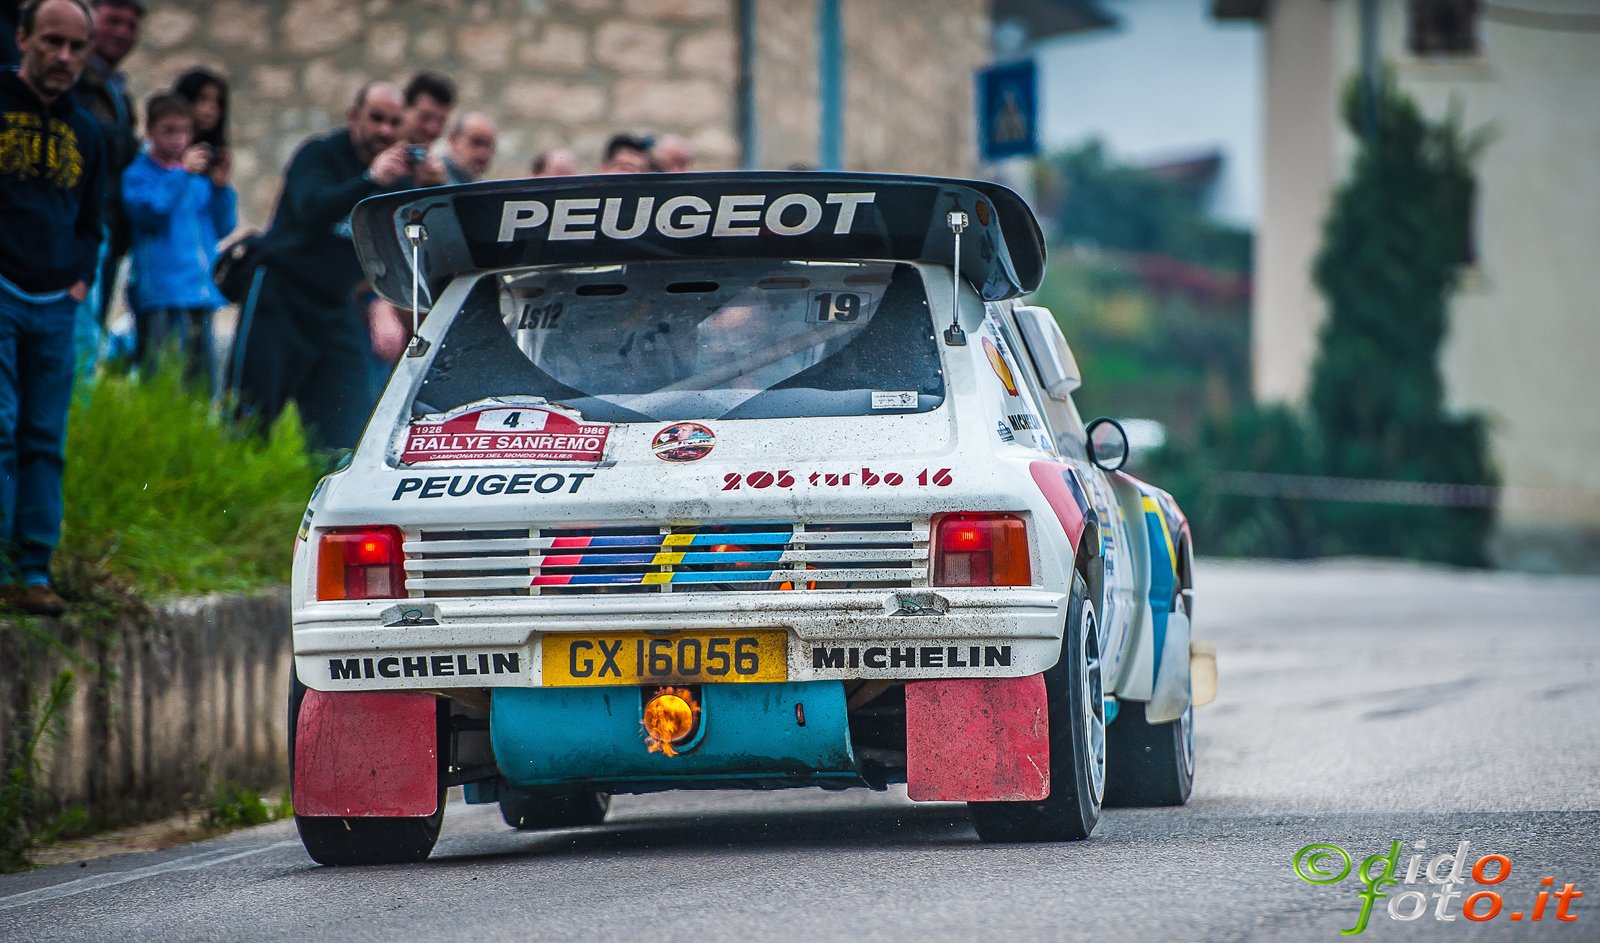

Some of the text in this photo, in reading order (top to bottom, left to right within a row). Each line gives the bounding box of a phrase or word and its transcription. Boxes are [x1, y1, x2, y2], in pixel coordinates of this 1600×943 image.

[497, 192, 876, 243] PEUGEOT
[518, 303, 564, 330] Ls12
[814, 293, 861, 322] 19
[415, 426, 443, 434] 1928
[503, 411, 522, 428] 4
[577, 426, 606, 435] 1986
[410, 435, 600, 451] RALLYE SANREMO
[392, 473, 595, 501] PEUGEOT
[721, 468, 953, 490] 205 turbo 16
[329, 652, 520, 680] MICHELIN
[569, 637, 760, 678] GX 16056
[812, 646, 1012, 668] MICHELIN
